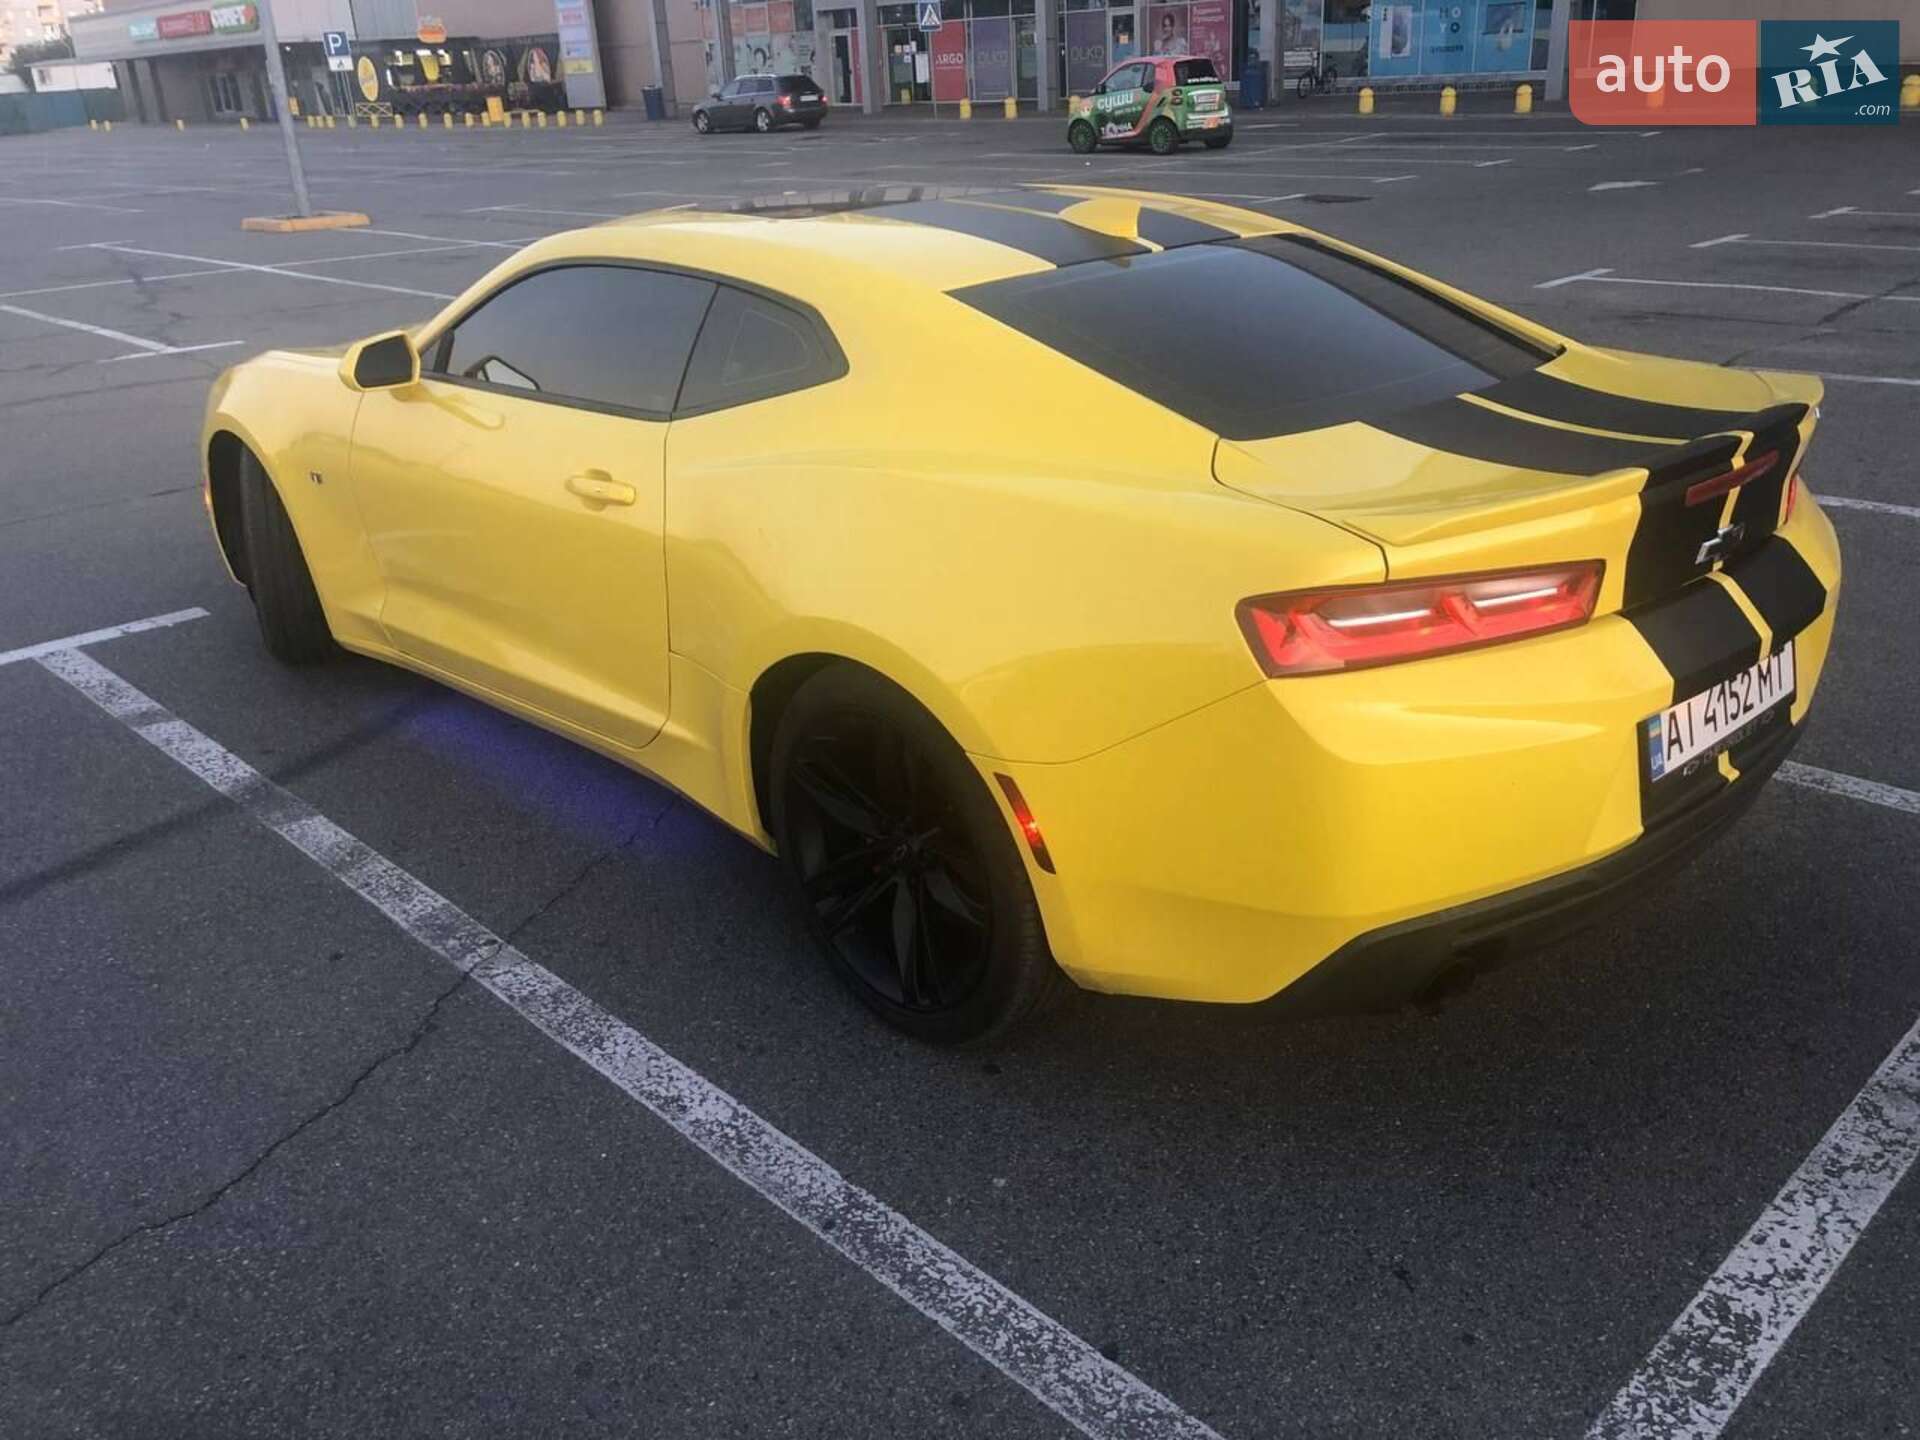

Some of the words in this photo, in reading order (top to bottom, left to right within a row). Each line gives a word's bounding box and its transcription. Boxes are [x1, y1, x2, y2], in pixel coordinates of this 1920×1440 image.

[327, 33, 342, 55] P
[935, 53, 964, 65] ARGO
[1667, 701, 1694, 761] AI
[1703, 671, 1755, 732] 4152
